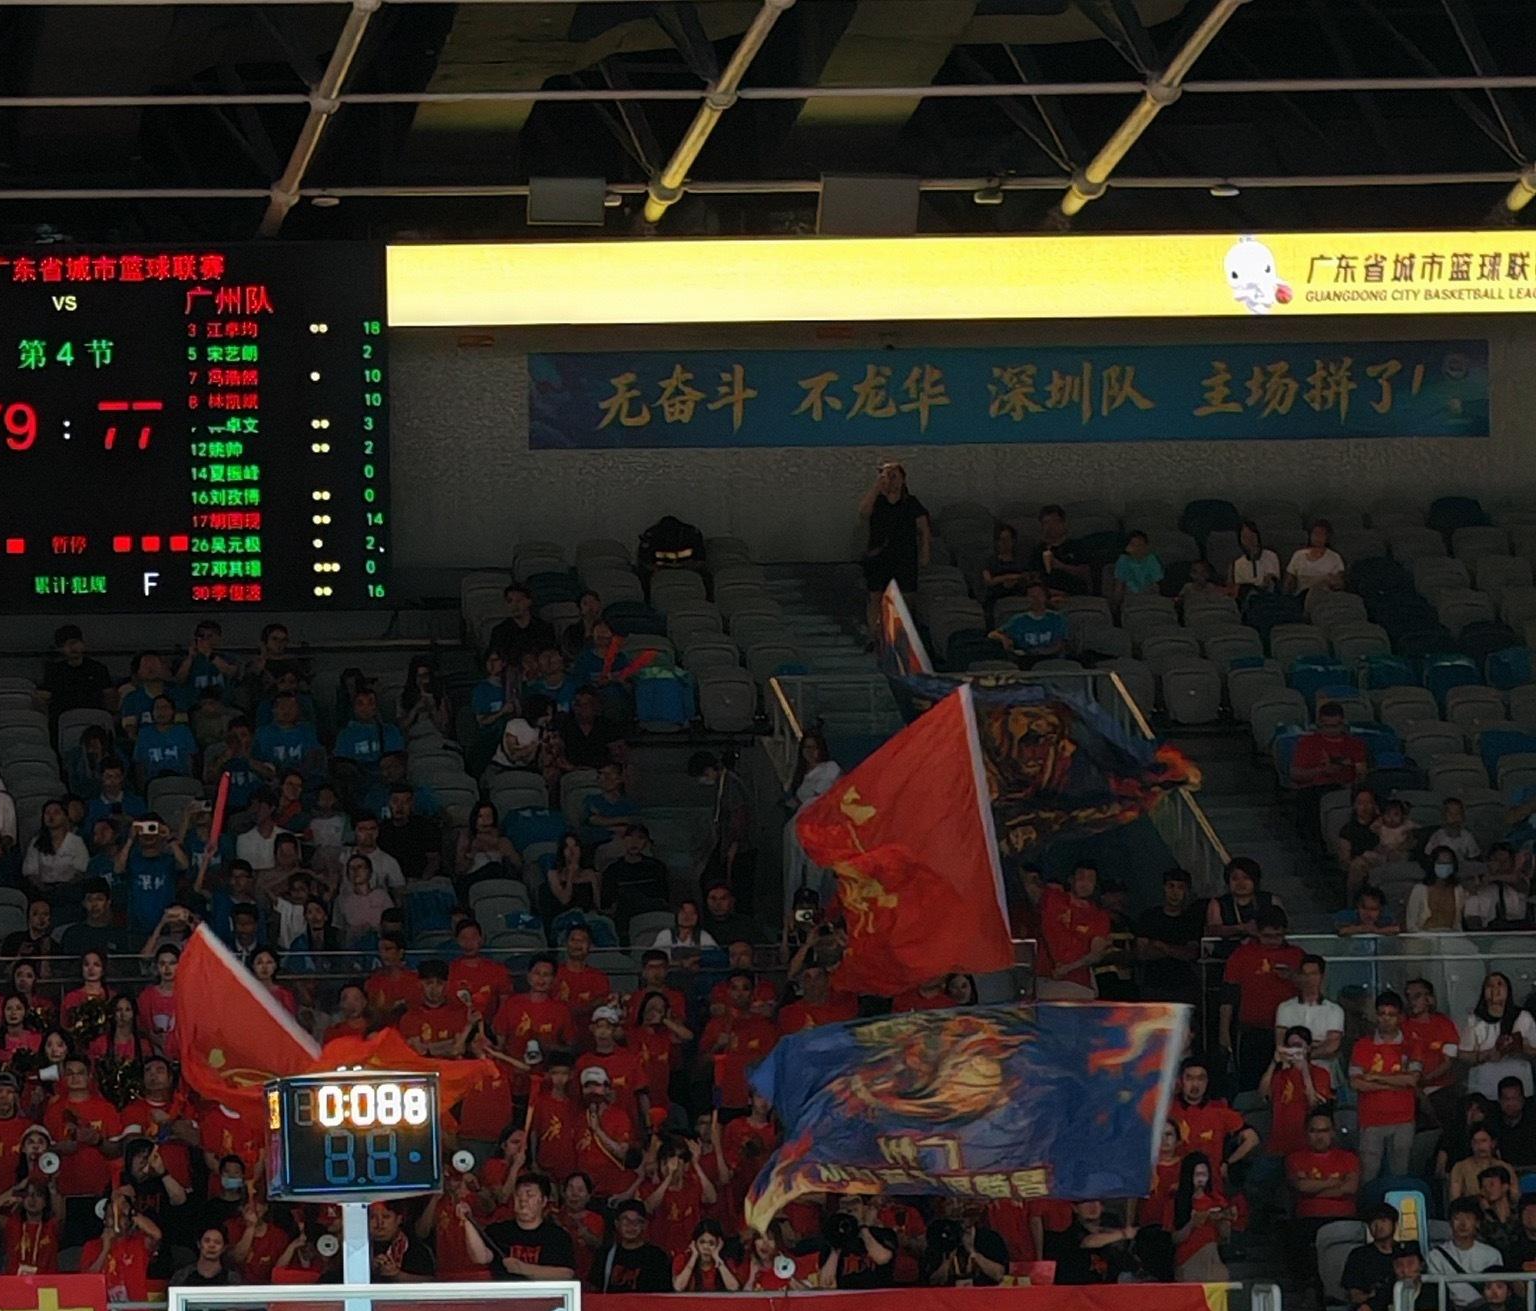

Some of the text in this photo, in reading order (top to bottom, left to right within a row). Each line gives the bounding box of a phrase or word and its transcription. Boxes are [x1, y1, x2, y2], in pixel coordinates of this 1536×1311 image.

[1307, 252, 1536, 283] 广东省城市篮球联
[53, 296, 78, 311] VS
[184, 286, 274, 315] 广州队
[1306, 289, 1387, 302] GUANGDONG
[1391, 288, 1419, 301] CITY
[1424, 287, 1505, 300] BASKETBALL
[598, 364, 756, 432] 无奋斗
[792, 362, 950, 432] 不龙华
[989, 360, 1155, 424] 深圳队
